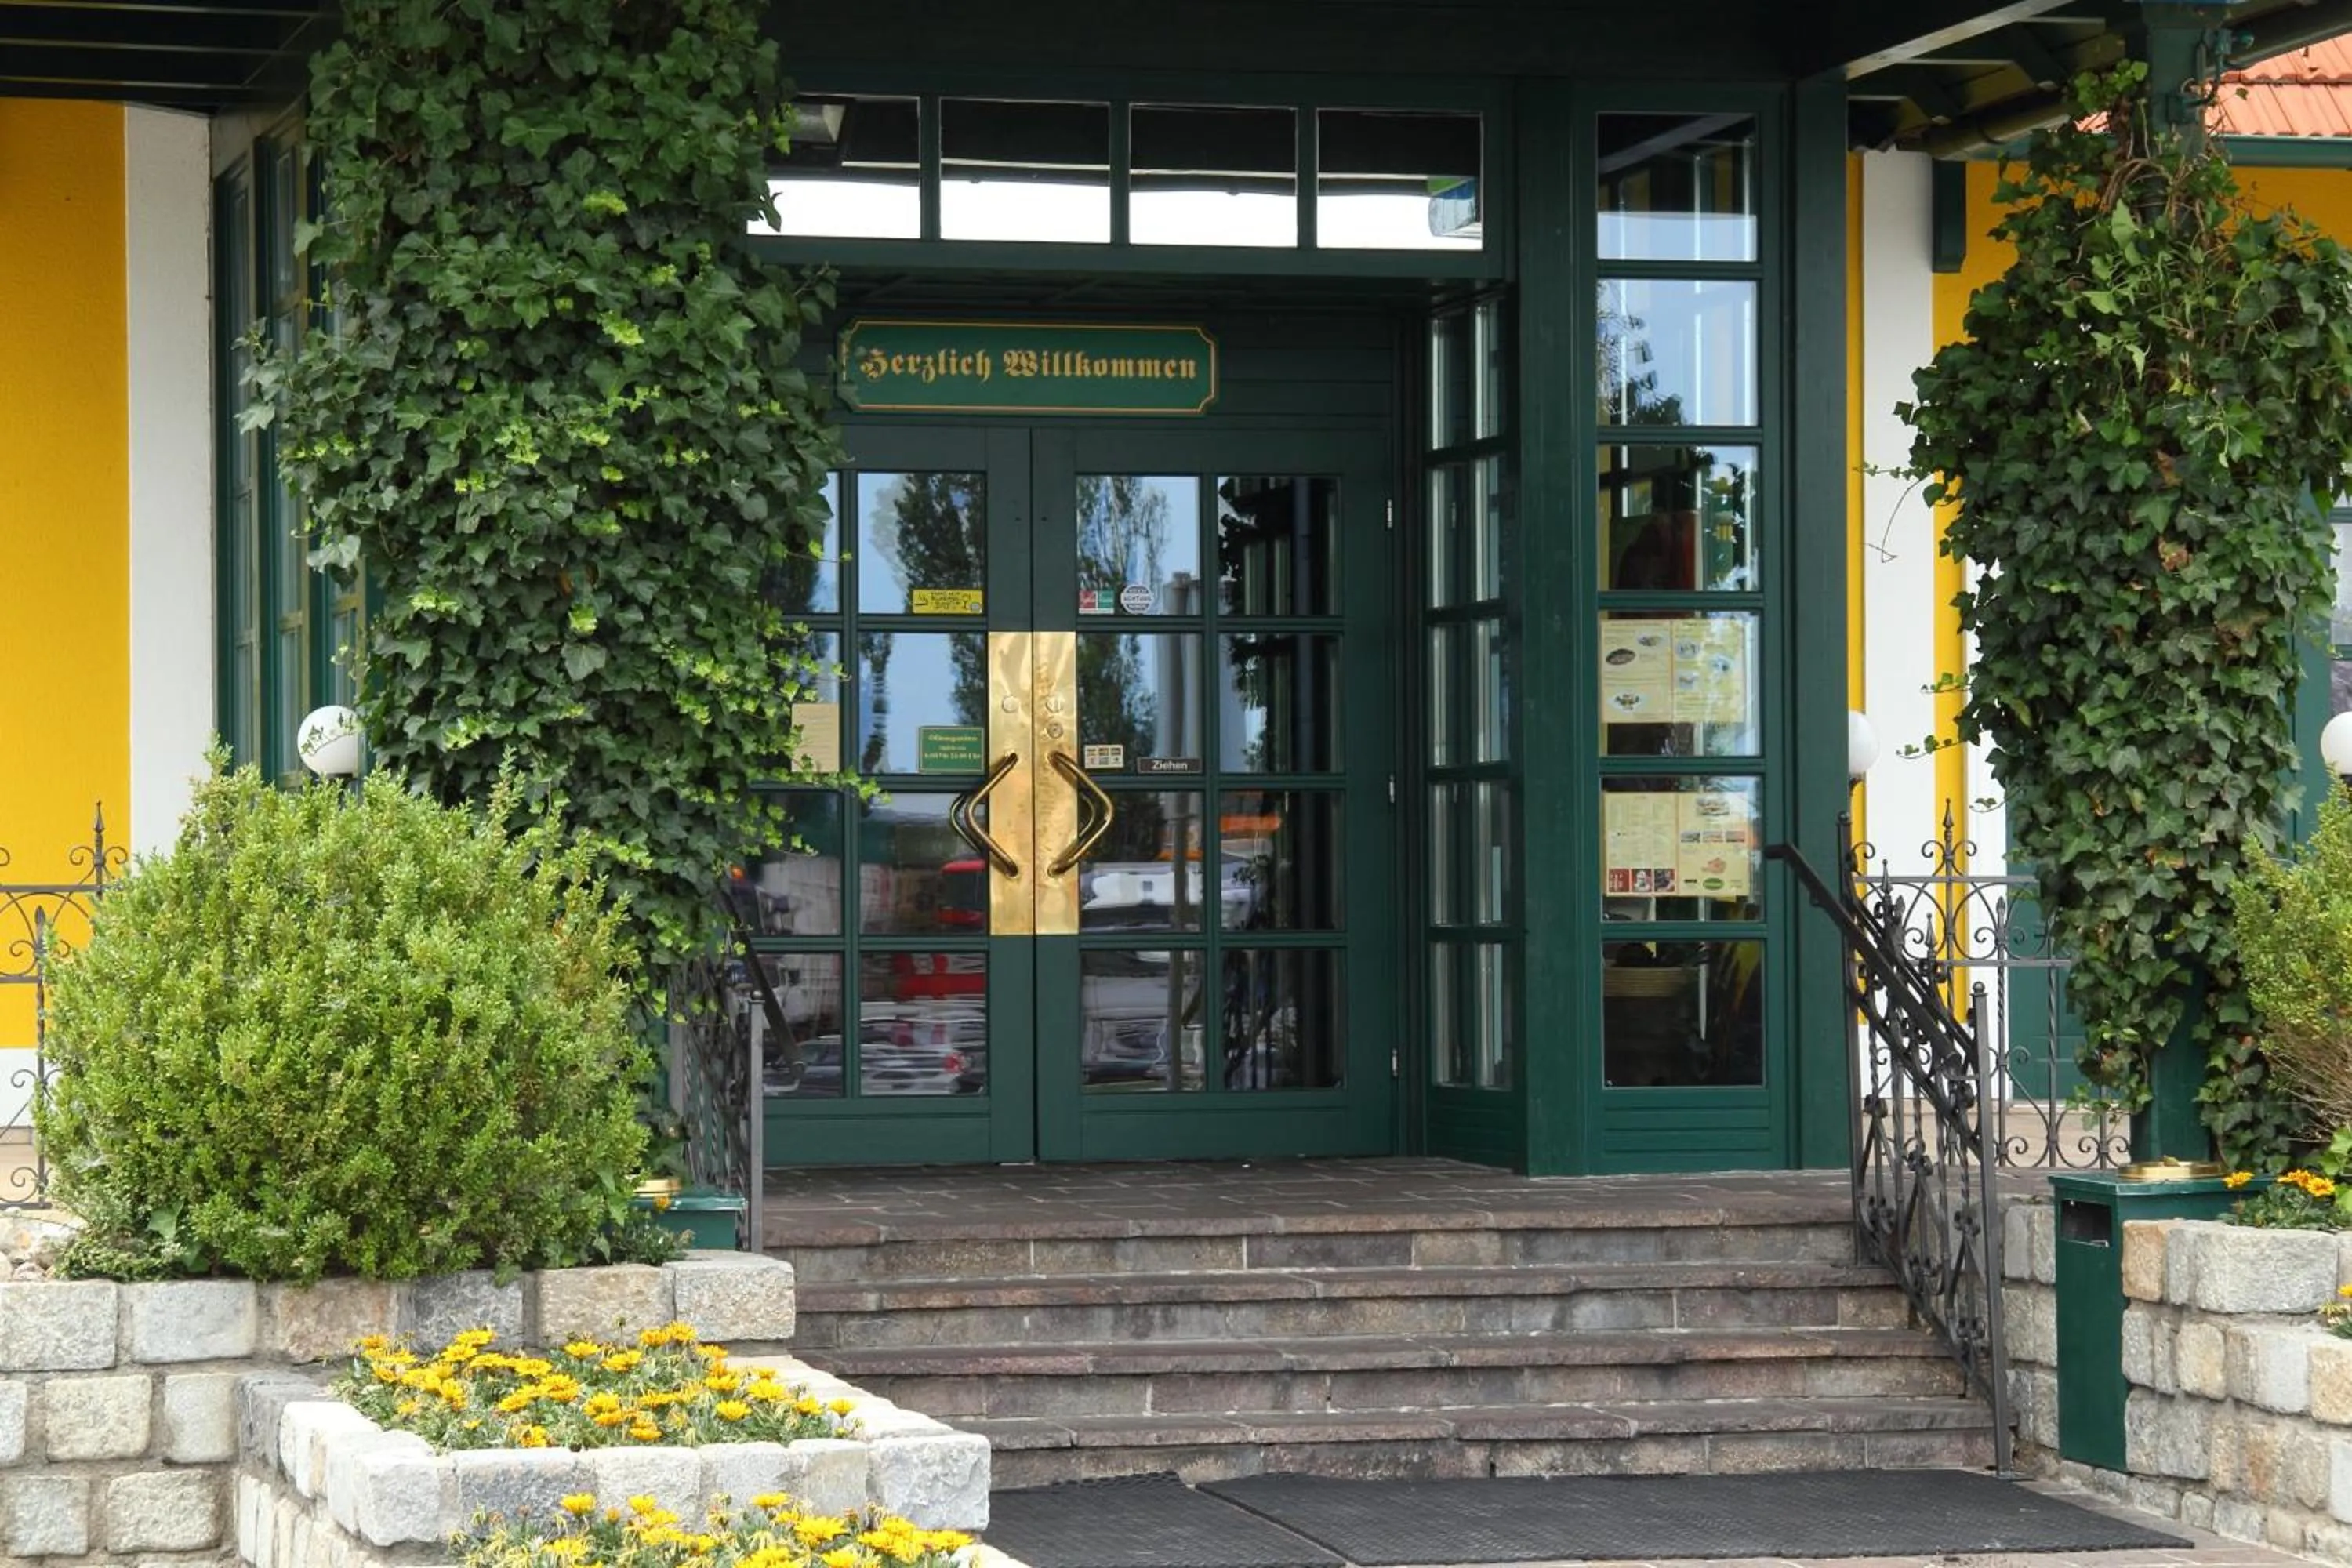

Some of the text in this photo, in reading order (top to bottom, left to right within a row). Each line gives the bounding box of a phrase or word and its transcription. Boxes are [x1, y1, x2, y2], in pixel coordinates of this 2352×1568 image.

[860, 349, 1196, 383] Herzlich Willkommen
[1151, 760, 1189, 771] Ziehen
